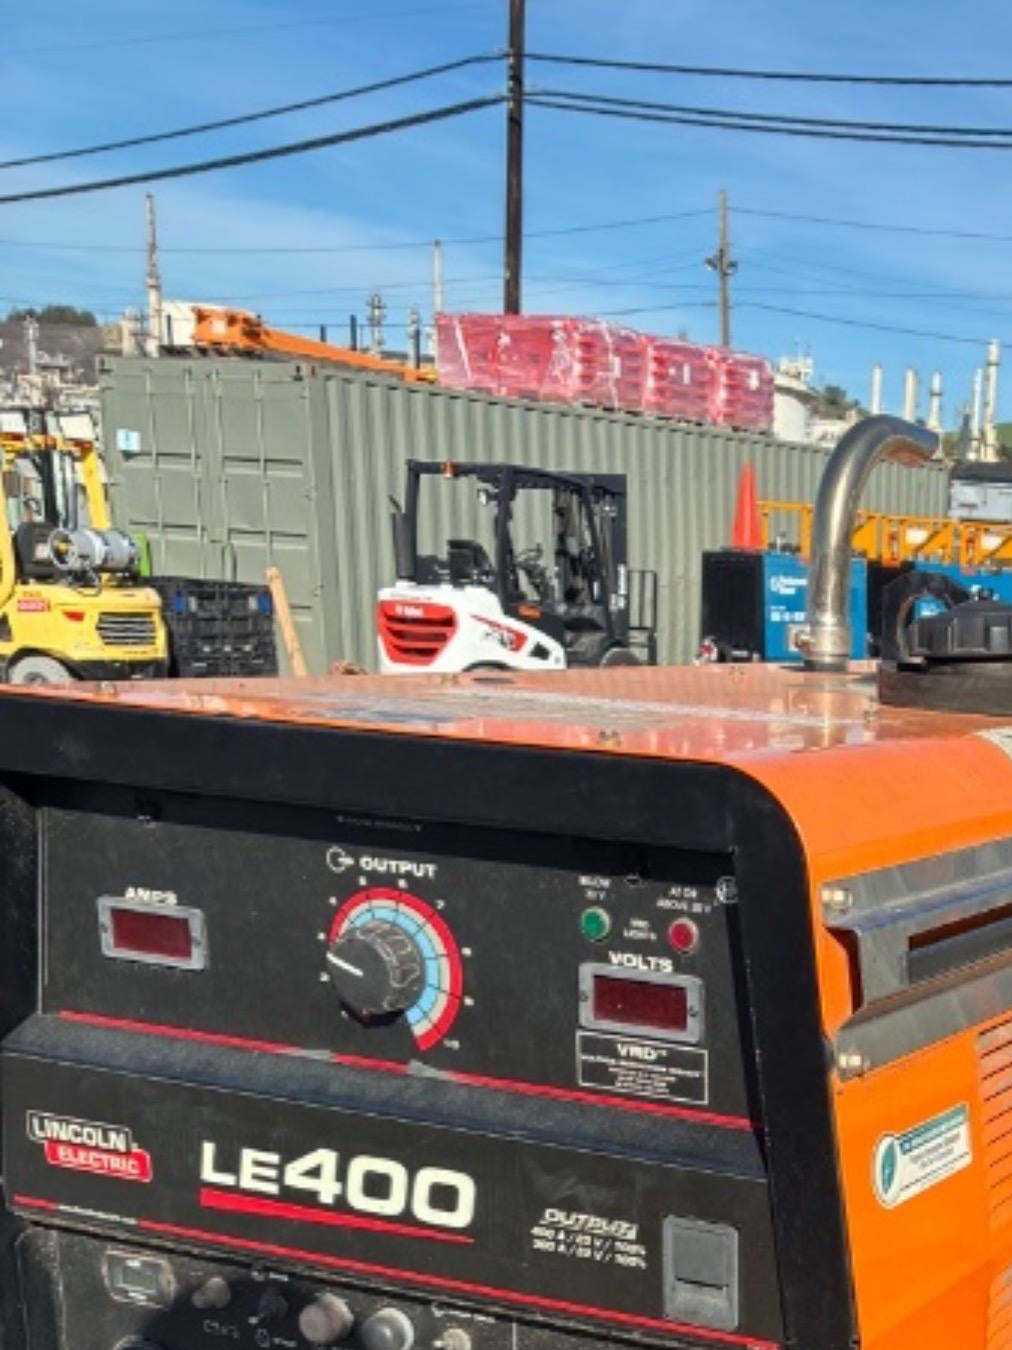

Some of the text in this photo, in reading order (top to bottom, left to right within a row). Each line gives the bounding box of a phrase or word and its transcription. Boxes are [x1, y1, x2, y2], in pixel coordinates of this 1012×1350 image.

[359, 857, 438, 878] OUTPUT
[608, 951, 673, 973] VOLTS
[32, 1115, 126, 1152] LINCOLN
[57, 1145, 139, 1174] ELECTRIC
[200, 1139, 476, 1228] LE400
